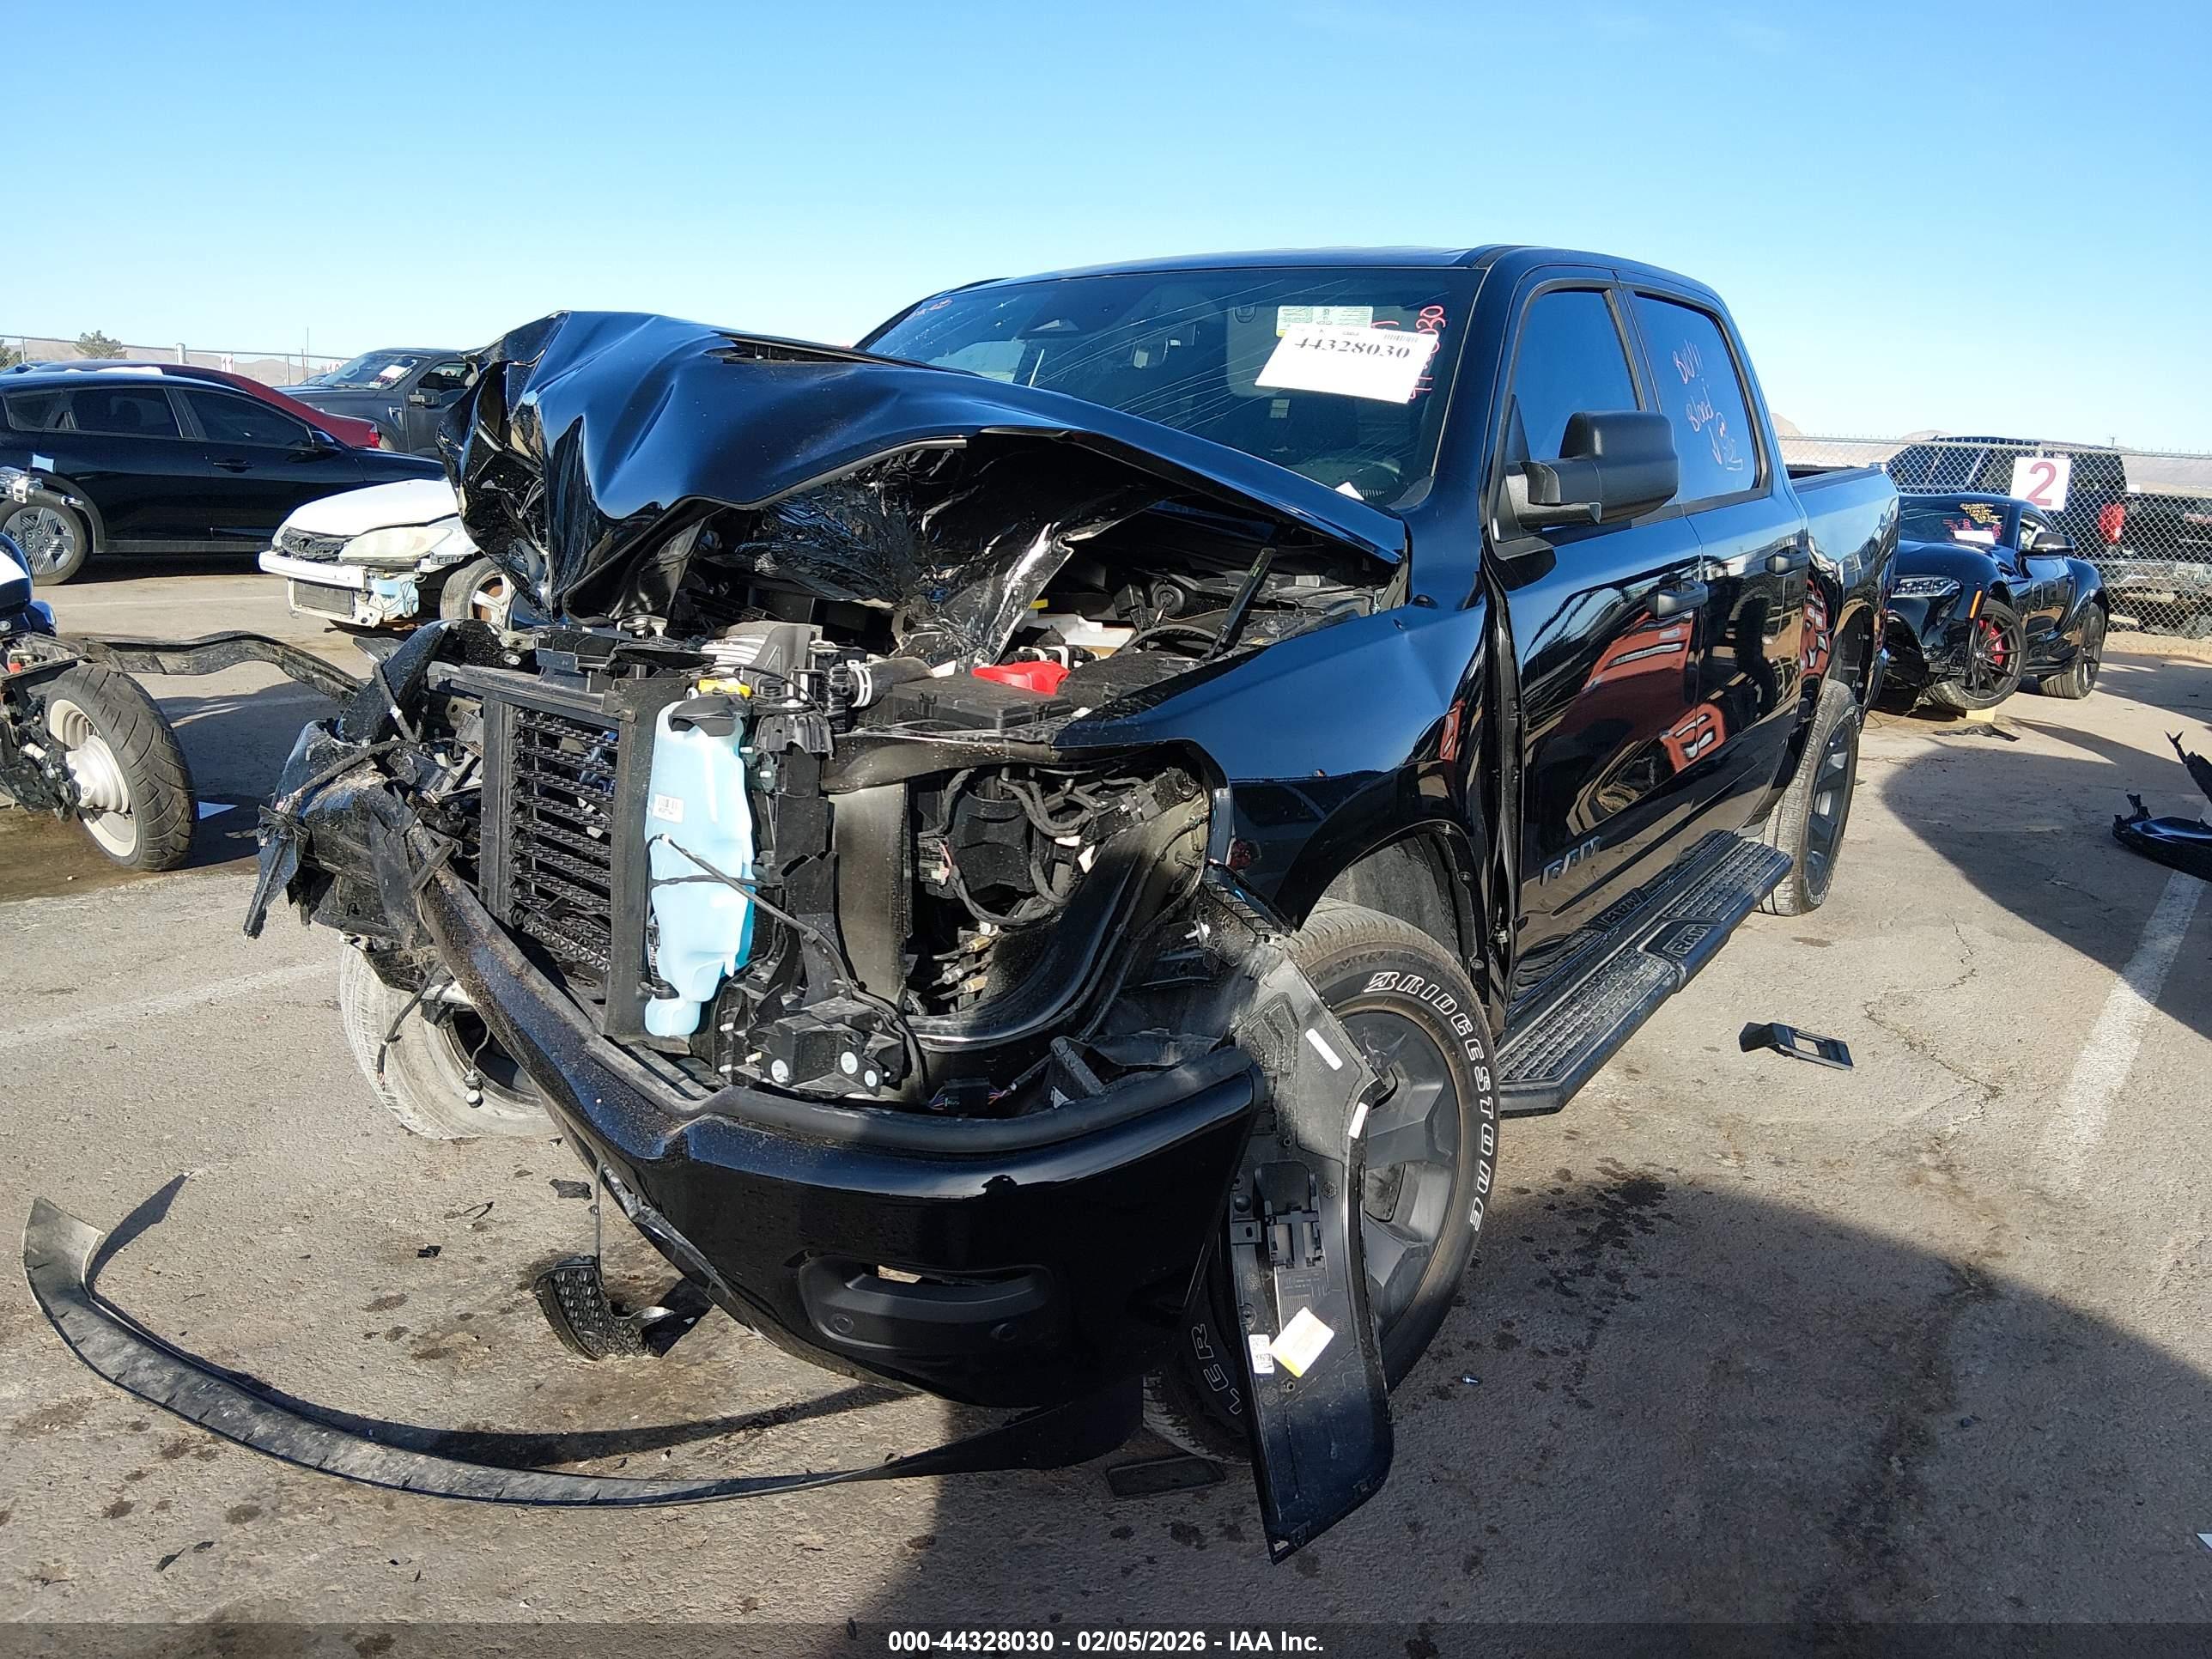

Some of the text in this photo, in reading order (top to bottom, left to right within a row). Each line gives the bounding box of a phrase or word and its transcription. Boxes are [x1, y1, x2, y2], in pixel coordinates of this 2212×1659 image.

[1294, 337, 1411, 359] 44328030
[2026, 461, 2057, 507] 2
[1540, 835, 1601, 887] RAM
[1363, 970, 1496, 1232] BRIDGESTONE
